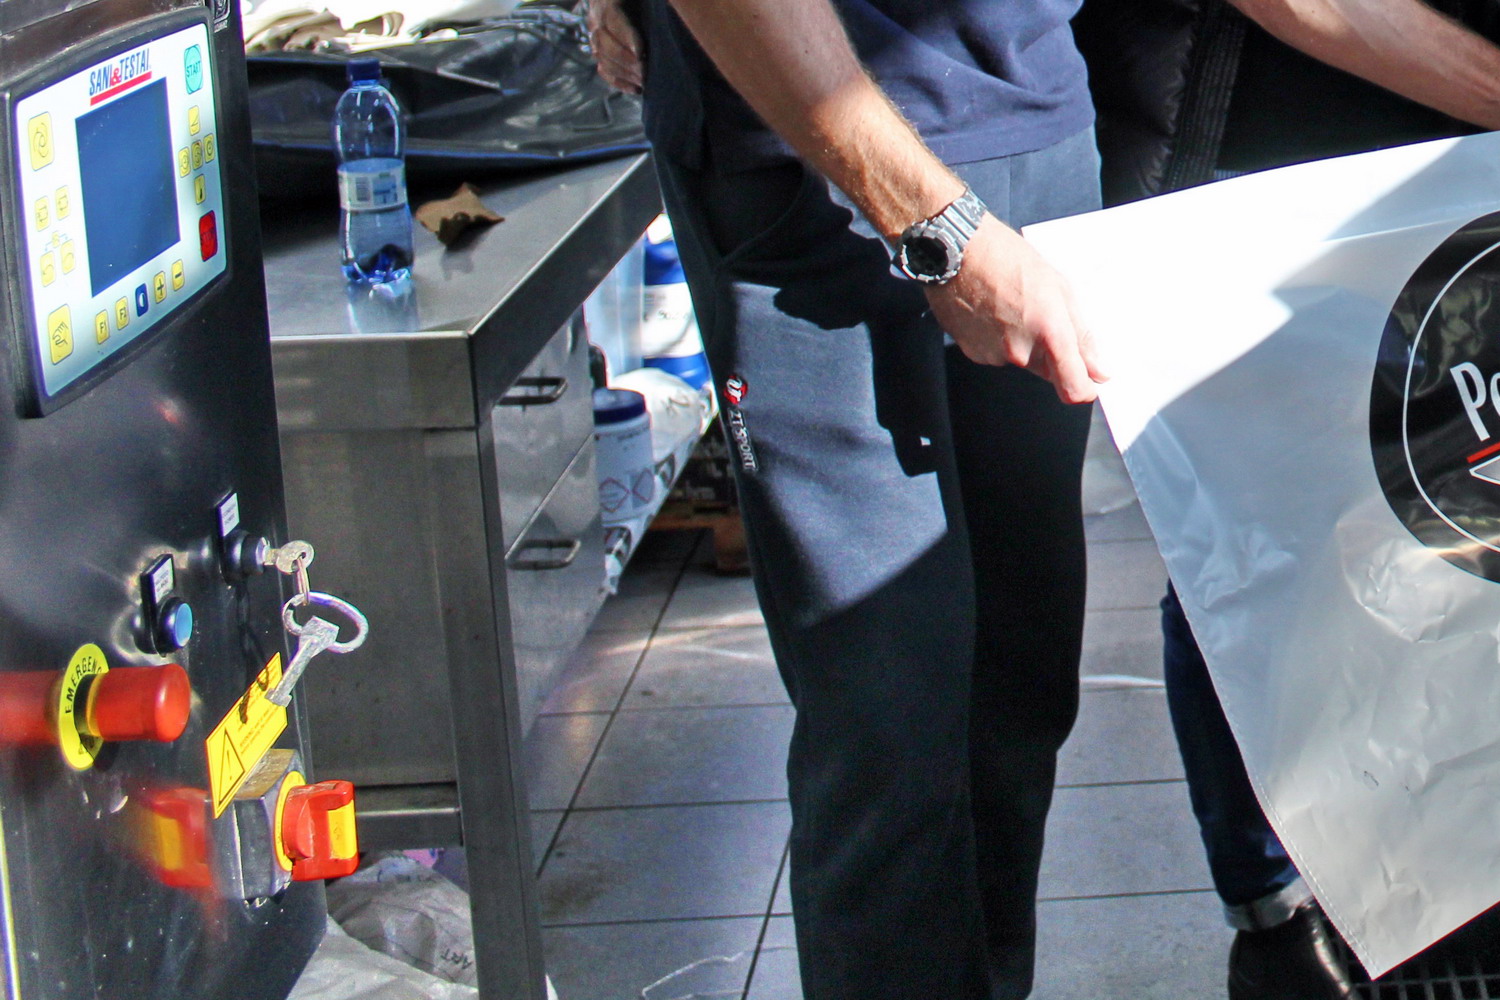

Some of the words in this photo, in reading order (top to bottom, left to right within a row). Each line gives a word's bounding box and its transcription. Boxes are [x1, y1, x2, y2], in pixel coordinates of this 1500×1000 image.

[89, 48, 150, 96] SANI&TESTAI
[186, 60, 201, 78] START
[119, 306, 127, 320] F2
[99, 321, 107, 334] F1
